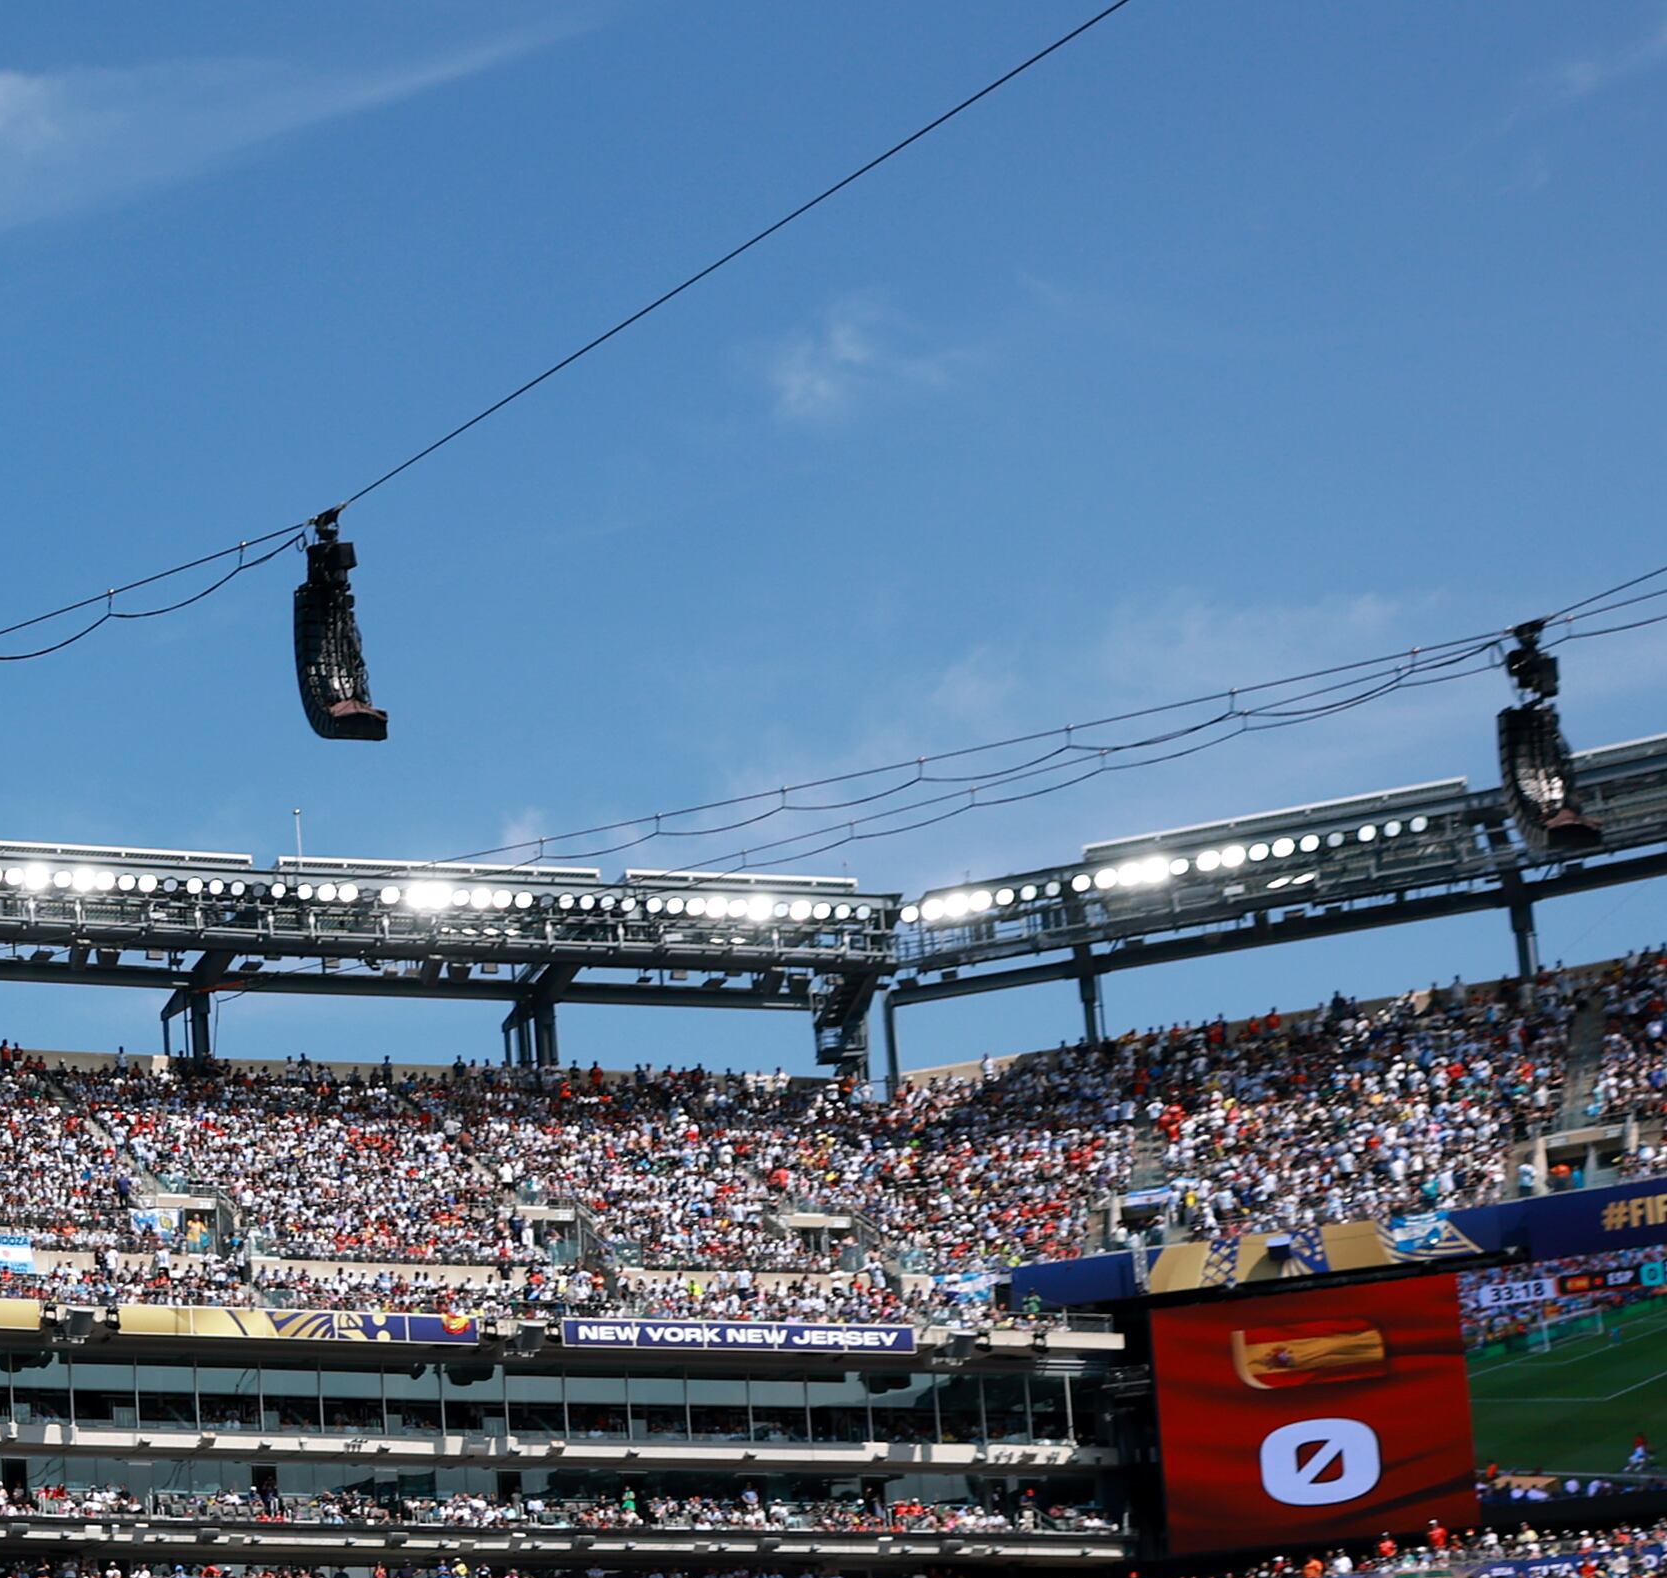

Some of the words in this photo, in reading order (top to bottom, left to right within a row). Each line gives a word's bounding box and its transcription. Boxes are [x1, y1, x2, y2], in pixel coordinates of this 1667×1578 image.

[1491, 1282, 1544, 1302] 33:18
[578, 1325, 640, 1342] NEW
[645, 1327, 721, 1344] YORK
[726, 1327, 788, 1345] NEW
[792, 1328, 898, 1347] JERSEY
[1259, 1417, 1381, 1506] 0
